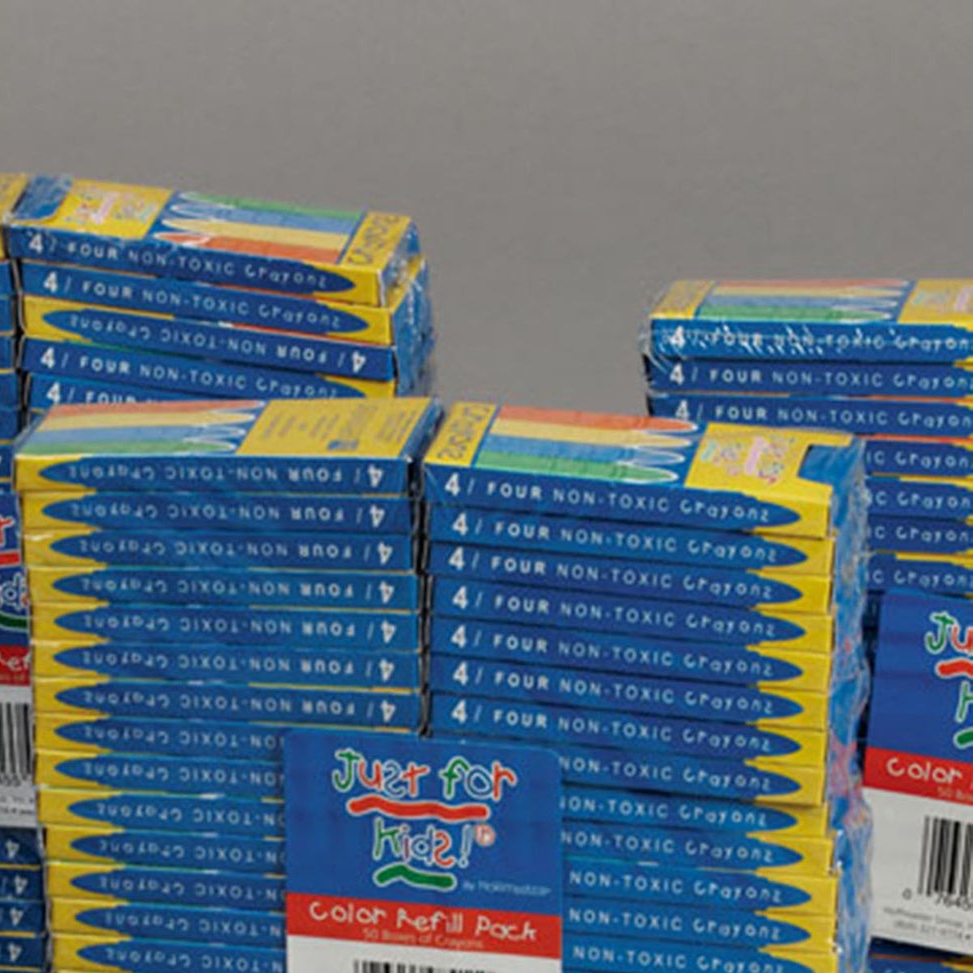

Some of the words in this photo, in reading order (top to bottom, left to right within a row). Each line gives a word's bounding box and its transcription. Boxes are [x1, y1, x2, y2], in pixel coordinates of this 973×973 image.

[67, 241, 118, 259] FOUR
[82, 280, 132, 298] FOUR
[276, 345, 327, 363] FOUR
[709, 368, 761, 383] FOUR
[771, 370, 883, 387] NON-TOXIC
[715, 405, 767, 420] FOUR
[777, 407, 887, 425] NON-TOXIC
[288, 467, 342, 482] FOUR
[487, 481, 542, 499] FOUR
[553, 488, 668, 512] NON-TOXIC
[494, 521, 549, 539] FOUR
[560, 528, 676, 552] NON-TOXIC
[300, 582, 353, 597] FOUR
[495, 594, 549, 613] FOUR
[560, 602, 674, 627] NON-TOXIC
[494, 670, 549, 689] FOUR
[559, 678, 673, 704] NON-TOXIC
[332, 747, 429, 793] Just
[440, 757, 518, 799] for
[886, 756, 963, 784] Color
[309, 902, 386, 925] Color
[396, 907, 464, 933] Refill
[475, 916, 538, 940] Pack
